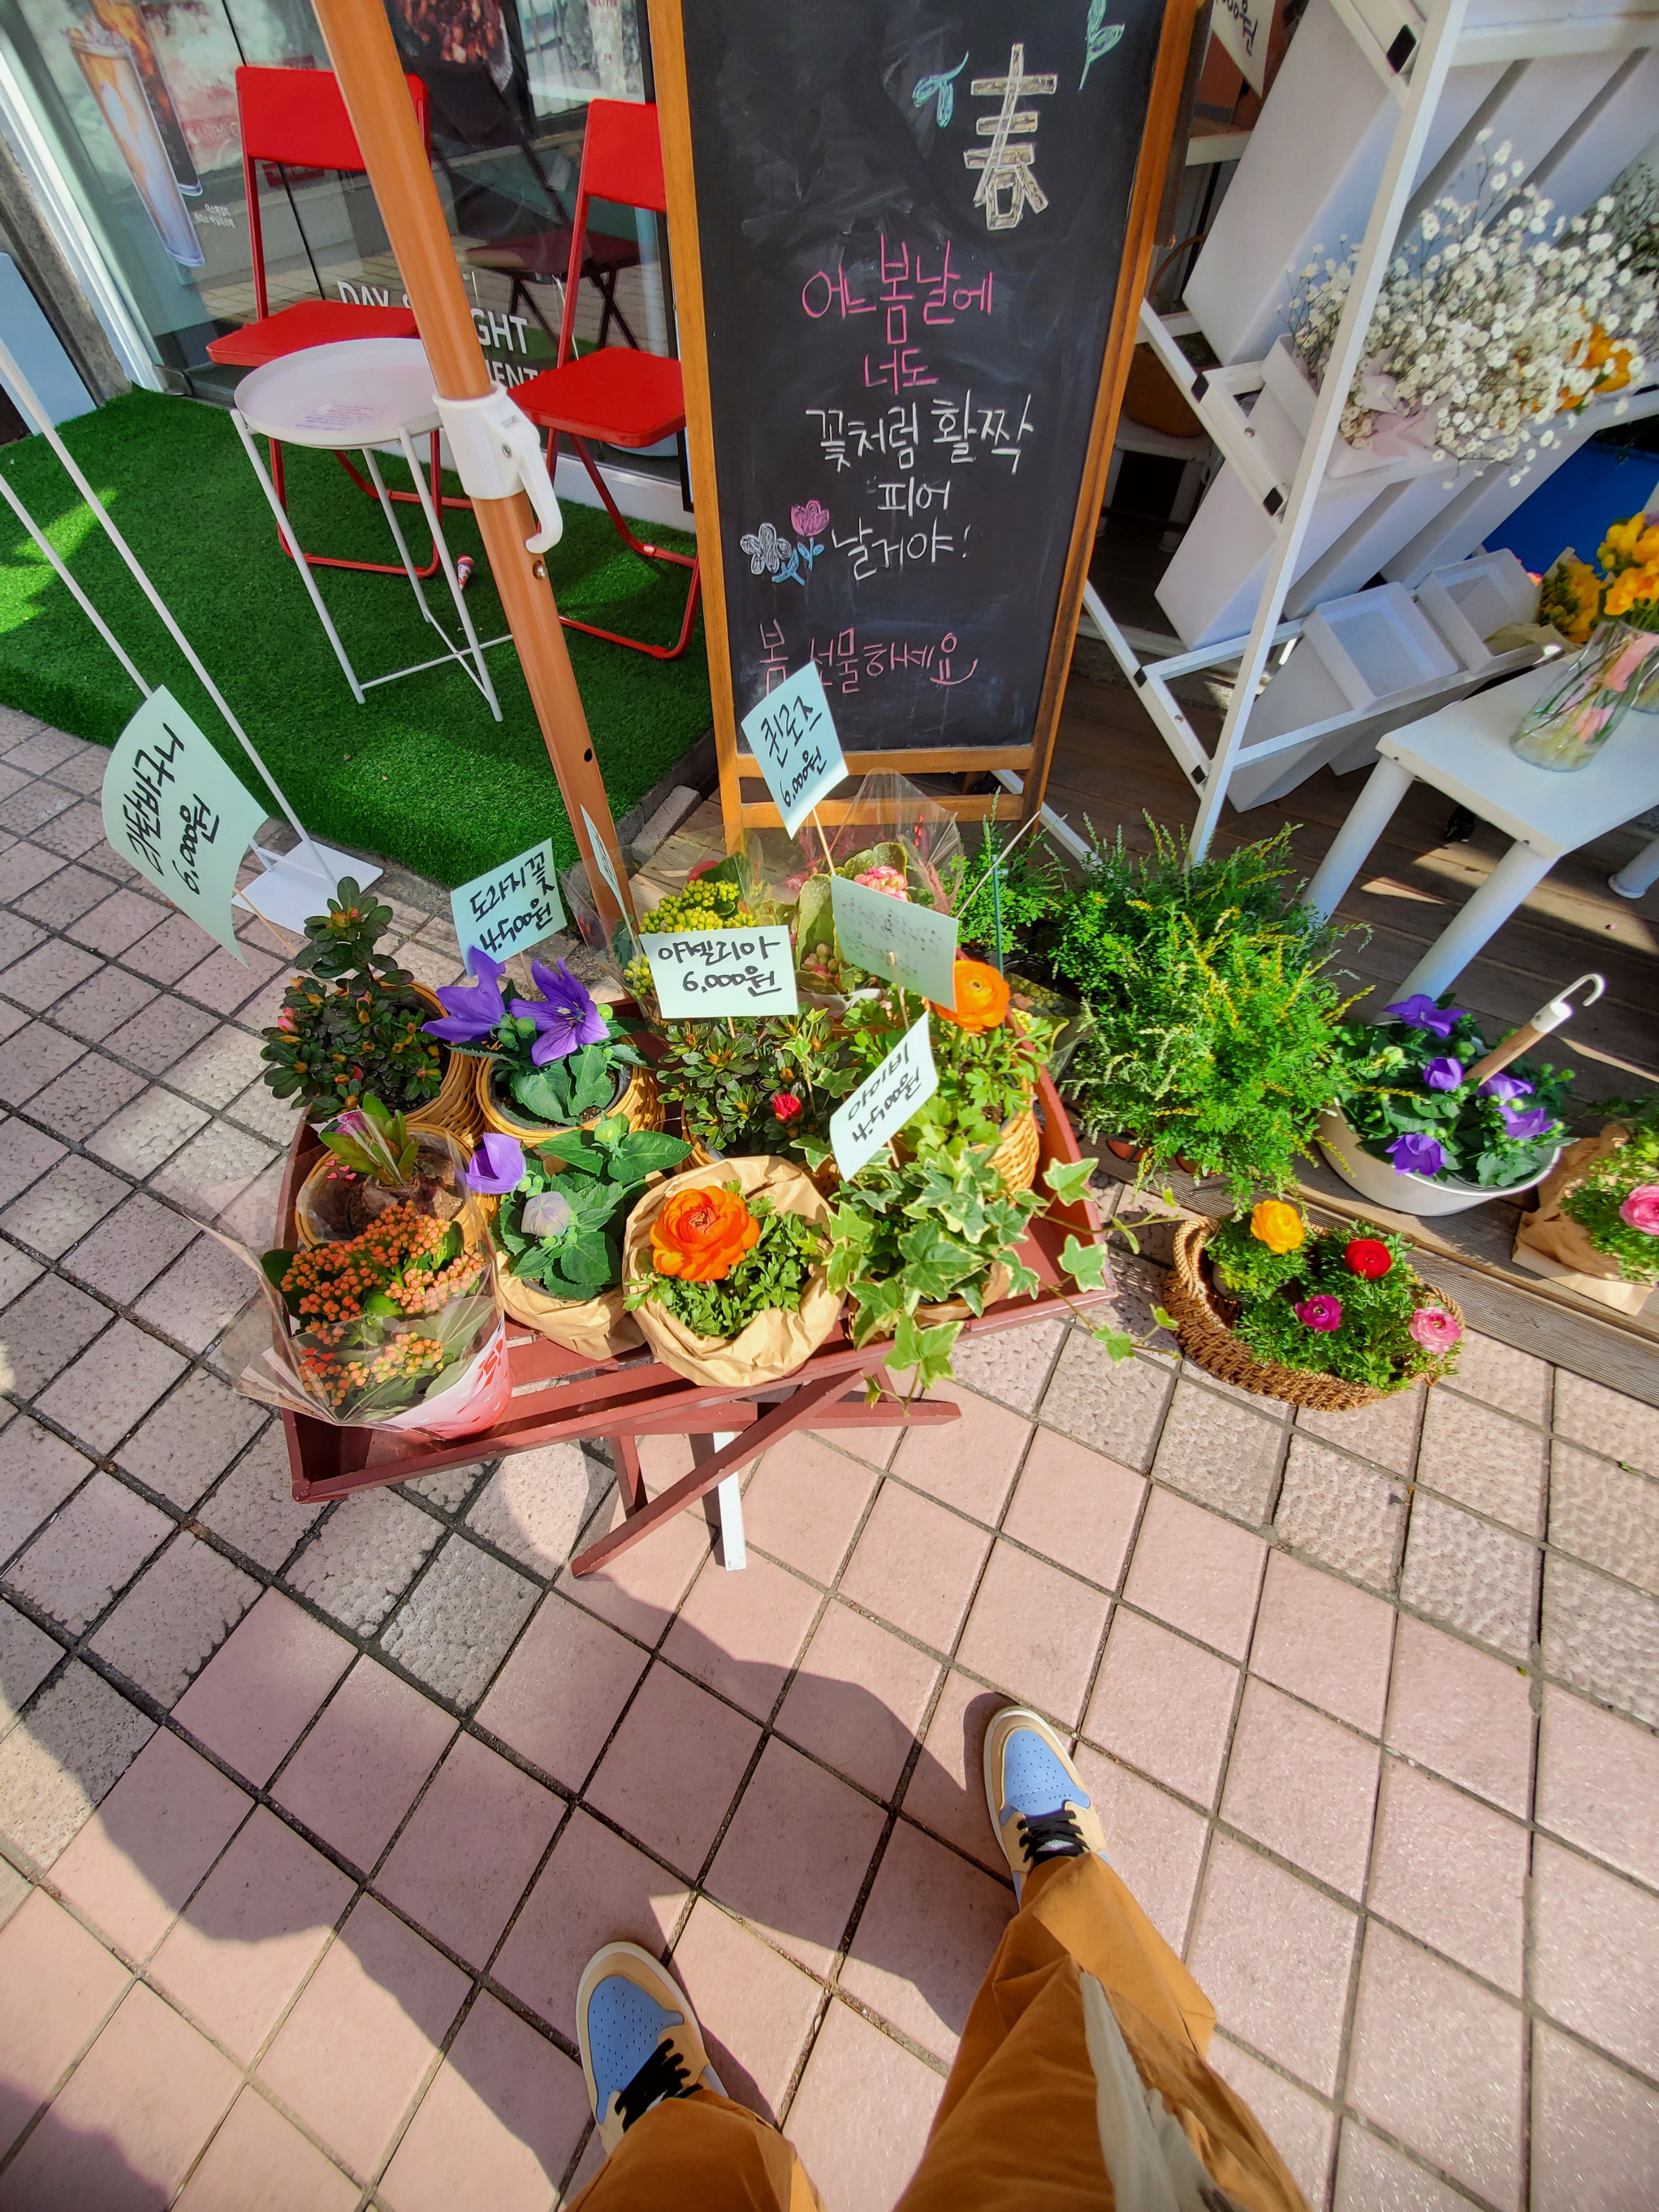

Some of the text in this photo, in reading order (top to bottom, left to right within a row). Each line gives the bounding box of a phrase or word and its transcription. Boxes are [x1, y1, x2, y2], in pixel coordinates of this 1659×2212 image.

[963, 43, 1058, 232] 春
[470, 308, 528, 355] GHT
[864, 348, 939, 396] 너도
[805, 388, 1035, 476] 꽃처럼 활짝
[876, 476, 950, 520] 피어
[759, 618, 789, 697] 봄
[760, 693, 824, 770] 퀸로즈
[122, 722, 185, 877] 라탄바구니
[469, 851, 555, 923] 도라지꽃
[847, 1041, 910, 1122] 아이비
